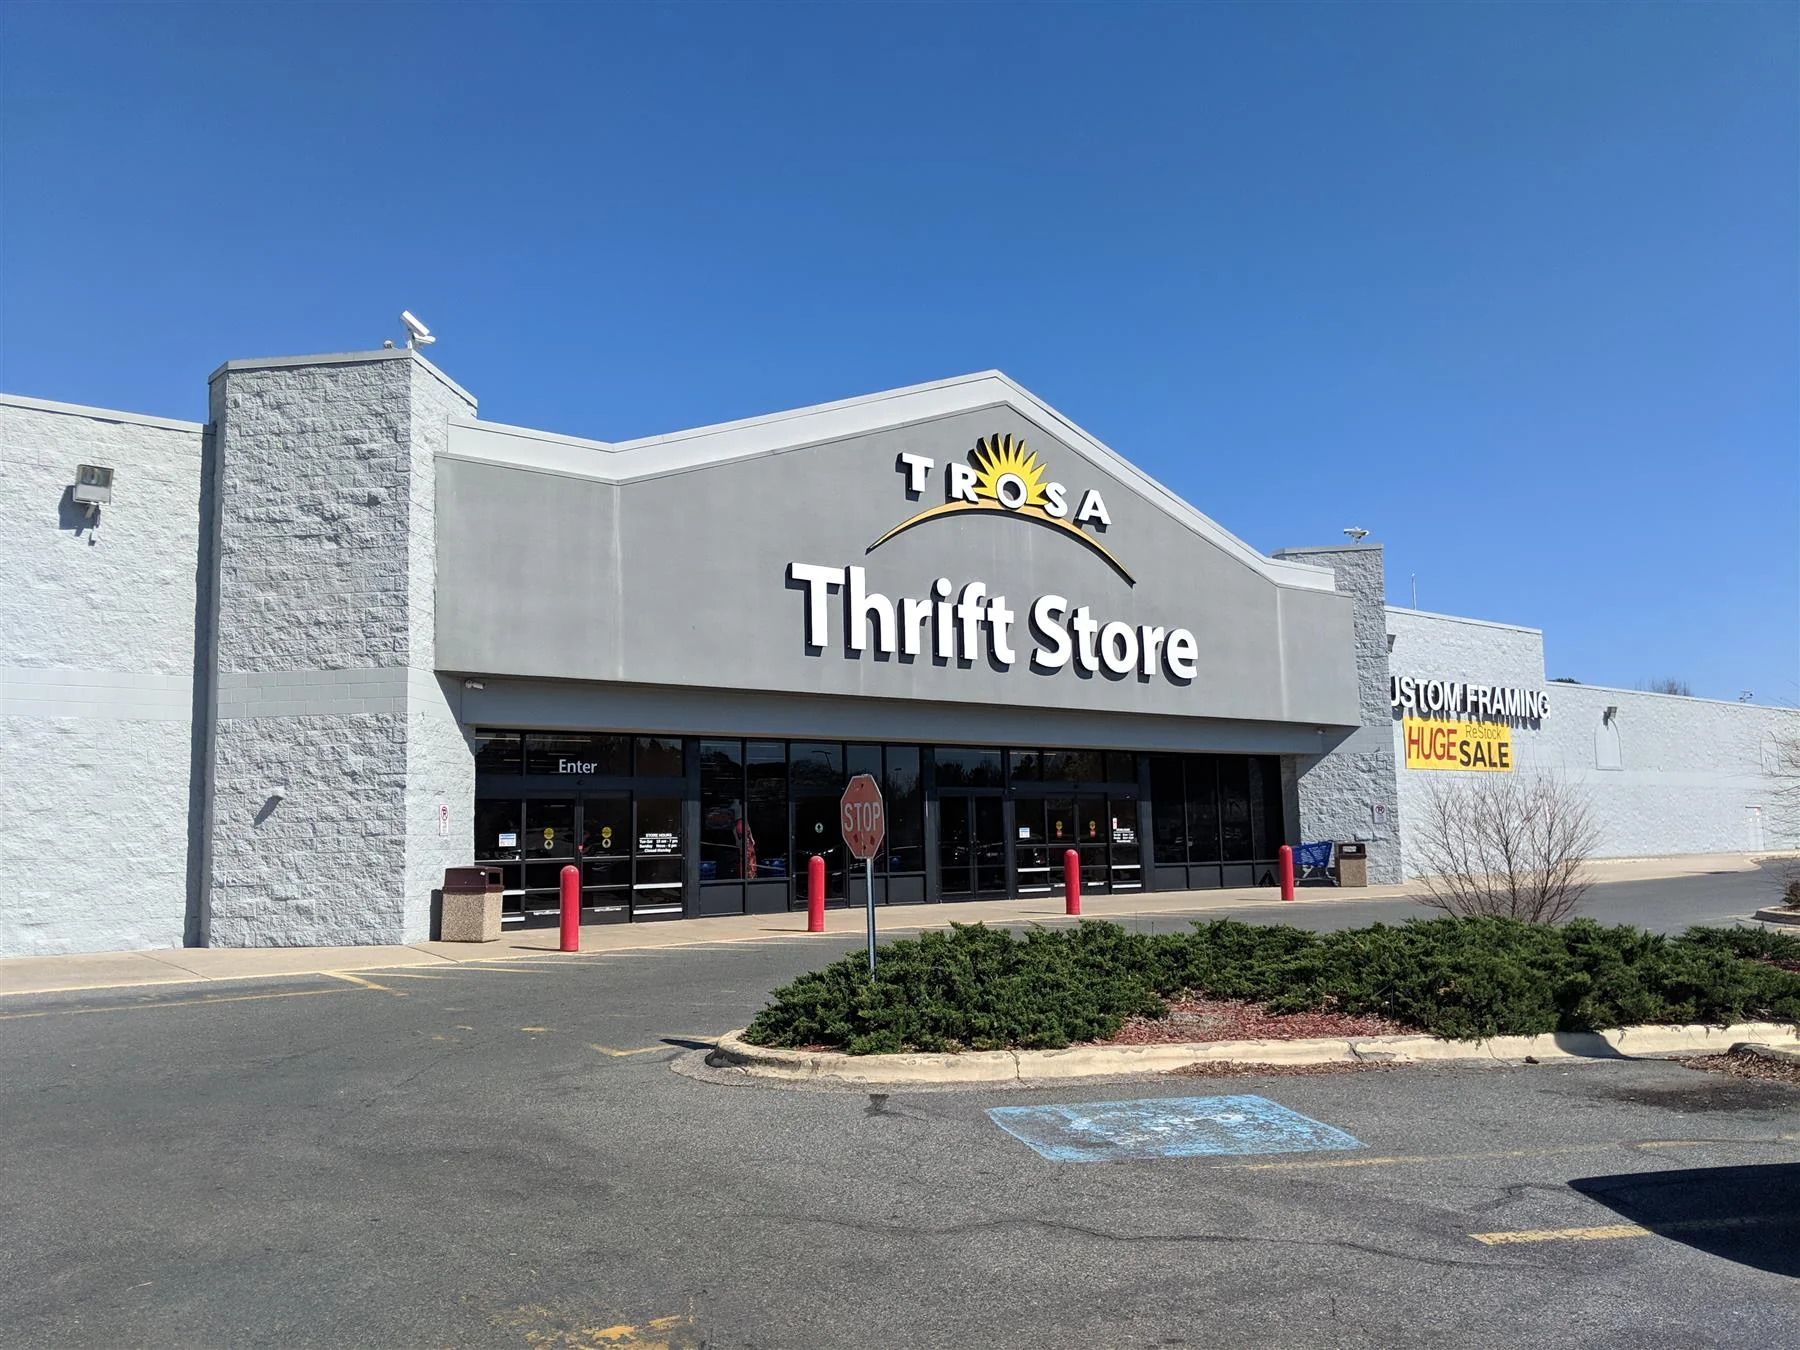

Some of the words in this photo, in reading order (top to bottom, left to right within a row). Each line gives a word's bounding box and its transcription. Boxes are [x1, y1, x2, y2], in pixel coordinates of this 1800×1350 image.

[900, 452, 1112, 525] TROSA
[788, 562, 1016, 666] Thrift
[1031, 594, 1199, 680] Store
[1465, 683, 1551, 720] FRAMING
[1407, 726, 1457, 761] HUGE
[1459, 739, 1510, 769] SALE
[1465, 724, 1502, 740] ReStock
[559, 758, 598, 774] Enter
[844, 802, 881, 832] STOP
